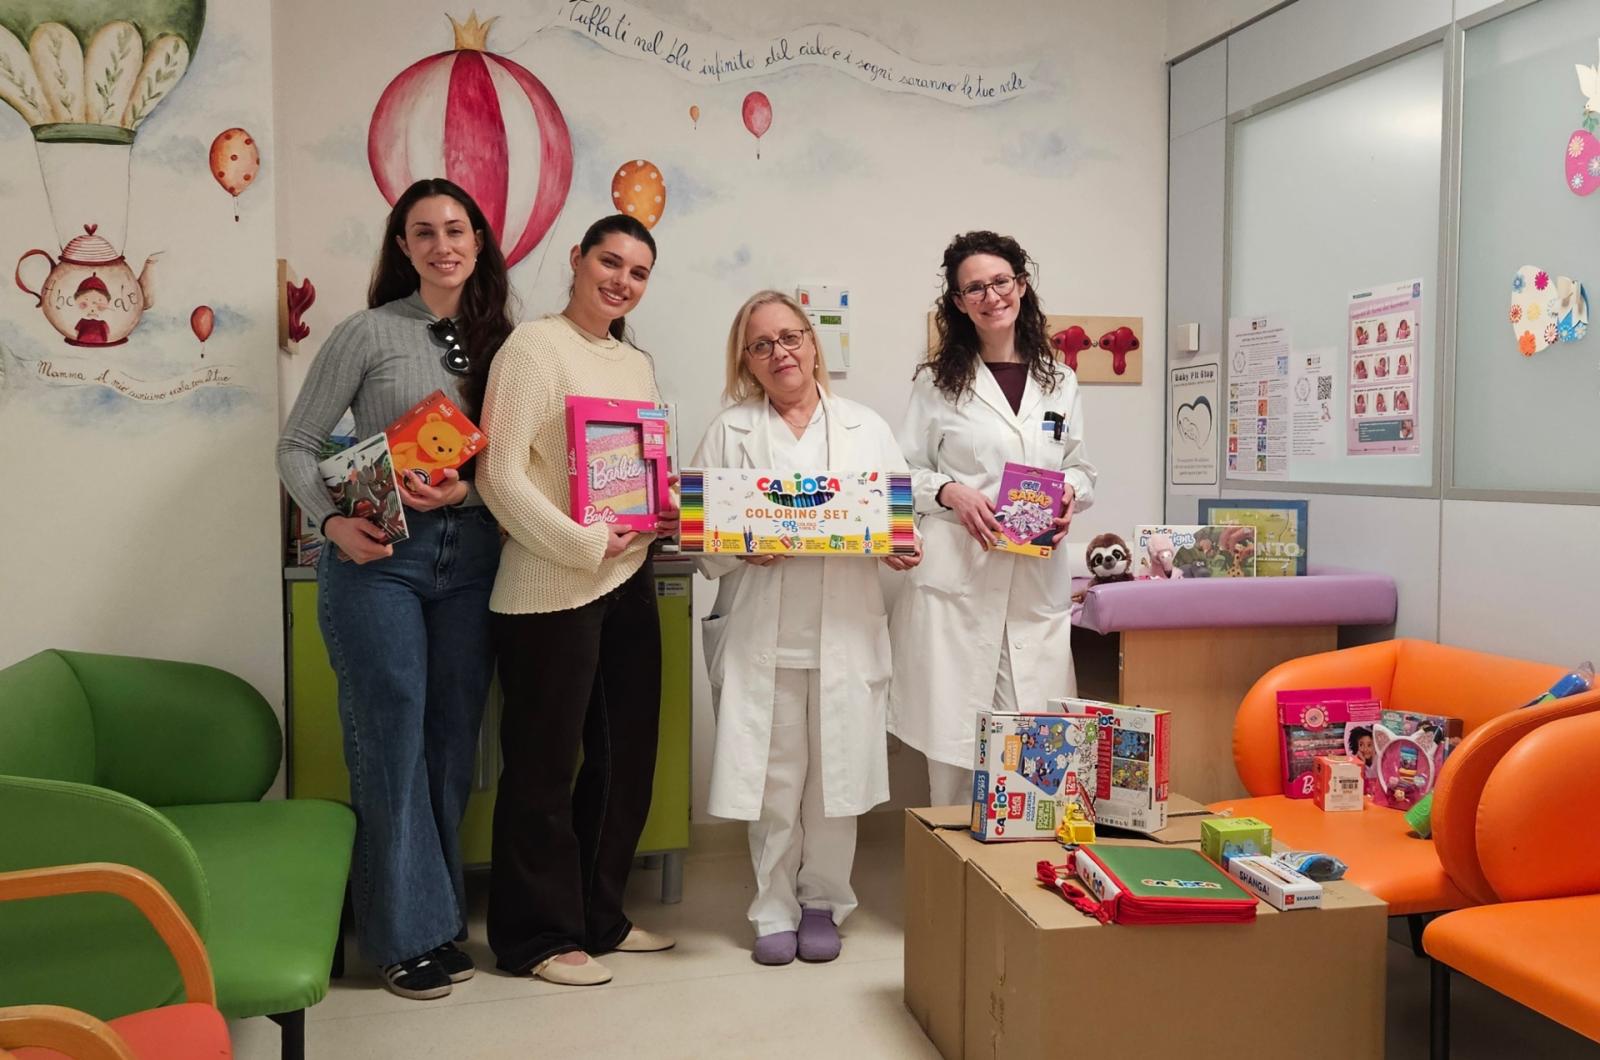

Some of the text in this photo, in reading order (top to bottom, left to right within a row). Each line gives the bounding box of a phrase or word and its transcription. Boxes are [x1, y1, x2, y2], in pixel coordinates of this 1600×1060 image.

[568, 0, 628, 42] Tuffati
[634, 31, 664, 55] nel
[664, 38, 691, 71] blu
[699, 50, 755, 81] infinito
[765, 38, 794, 67] del
[832, 50, 841, 60] e
[844, 49, 852, 63] i
[856, 60, 891, 81] sogni
[898, 76, 957, 93] saranno
[961, 73, 973, 99] le
[975, 75, 995, 97] tue
[1000, 72, 1026, 93] vele
[37, 360, 86, 380] Mamma
[590, 455, 645, 490] Barbie
[583, 505, 618, 524] Barbie
[745, 508, 849, 520] COLORING SET
[711, 539, 722, 548] 30
[1256, 542, 1300, 557] NTO
